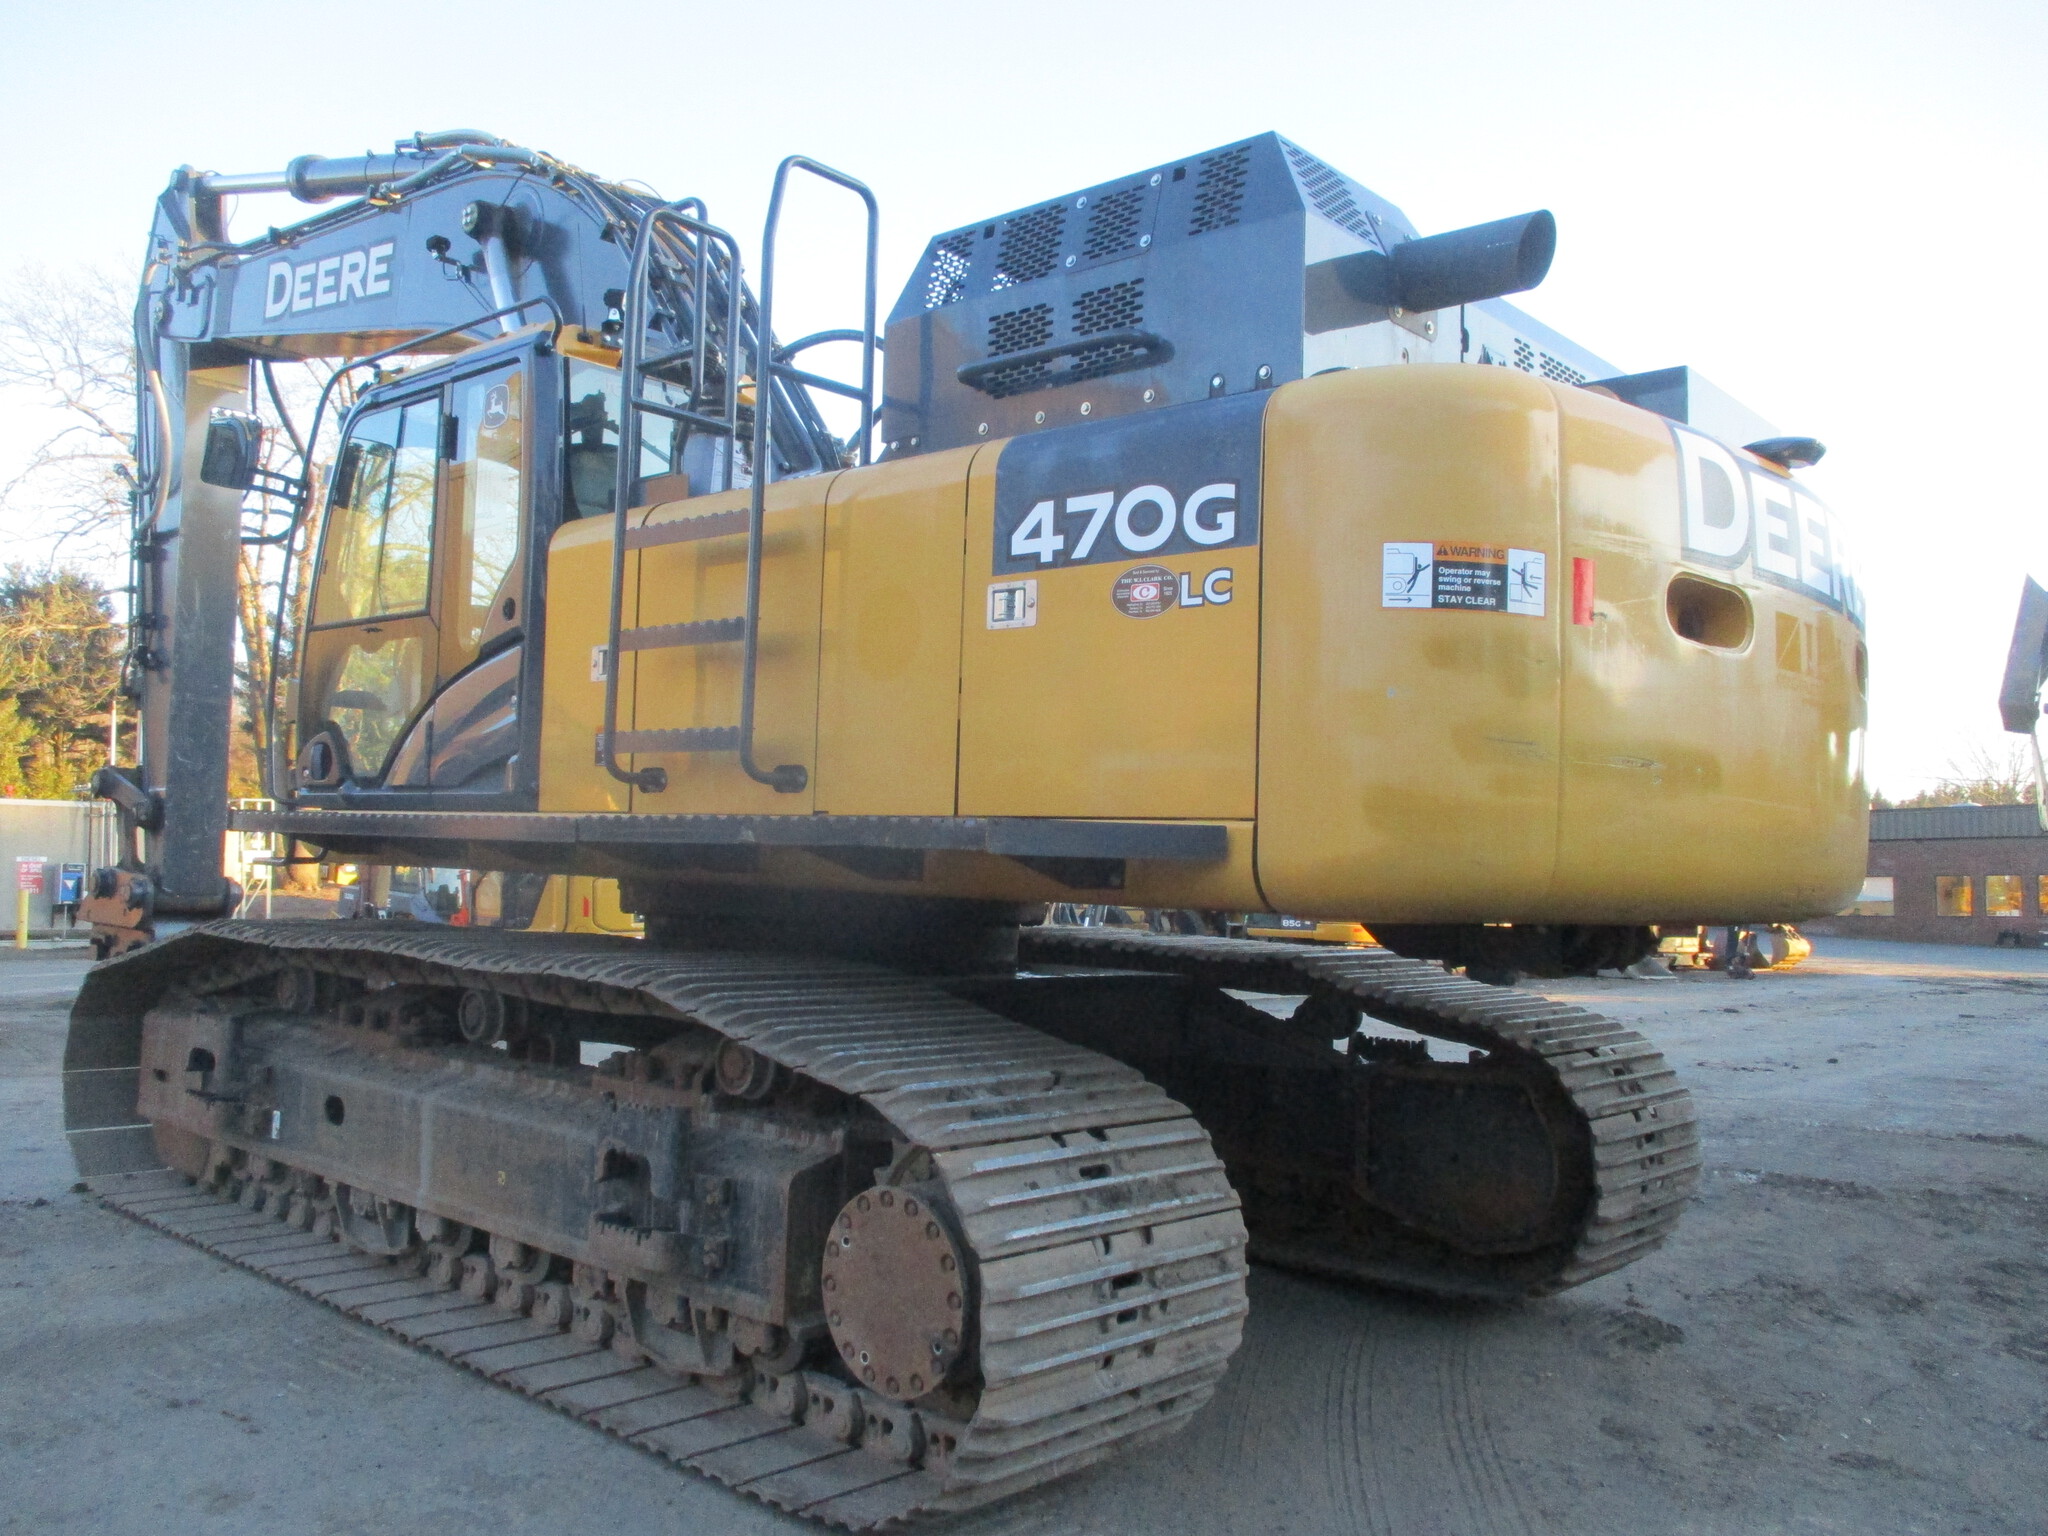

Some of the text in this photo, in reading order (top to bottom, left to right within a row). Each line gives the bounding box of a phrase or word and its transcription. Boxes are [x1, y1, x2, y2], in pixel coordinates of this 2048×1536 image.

[265, 242, 394, 318] DEERE
[1011, 483, 1236, 563] 470G
[1673, 427, 1864, 624] DEER
[1450, 546, 1505, 560] WARNING
[1438, 566, 1491, 578] Operator may
[1438, 575, 1462, 584] swing
[1473, 578, 1502, 586] reverse
[1180, 569, 1232, 607] LC
[1438, 584, 1472, 592] machine
[1438, 594, 1496, 606] STAY CLEAR
[1282, 919, 1302, 928] 85G
